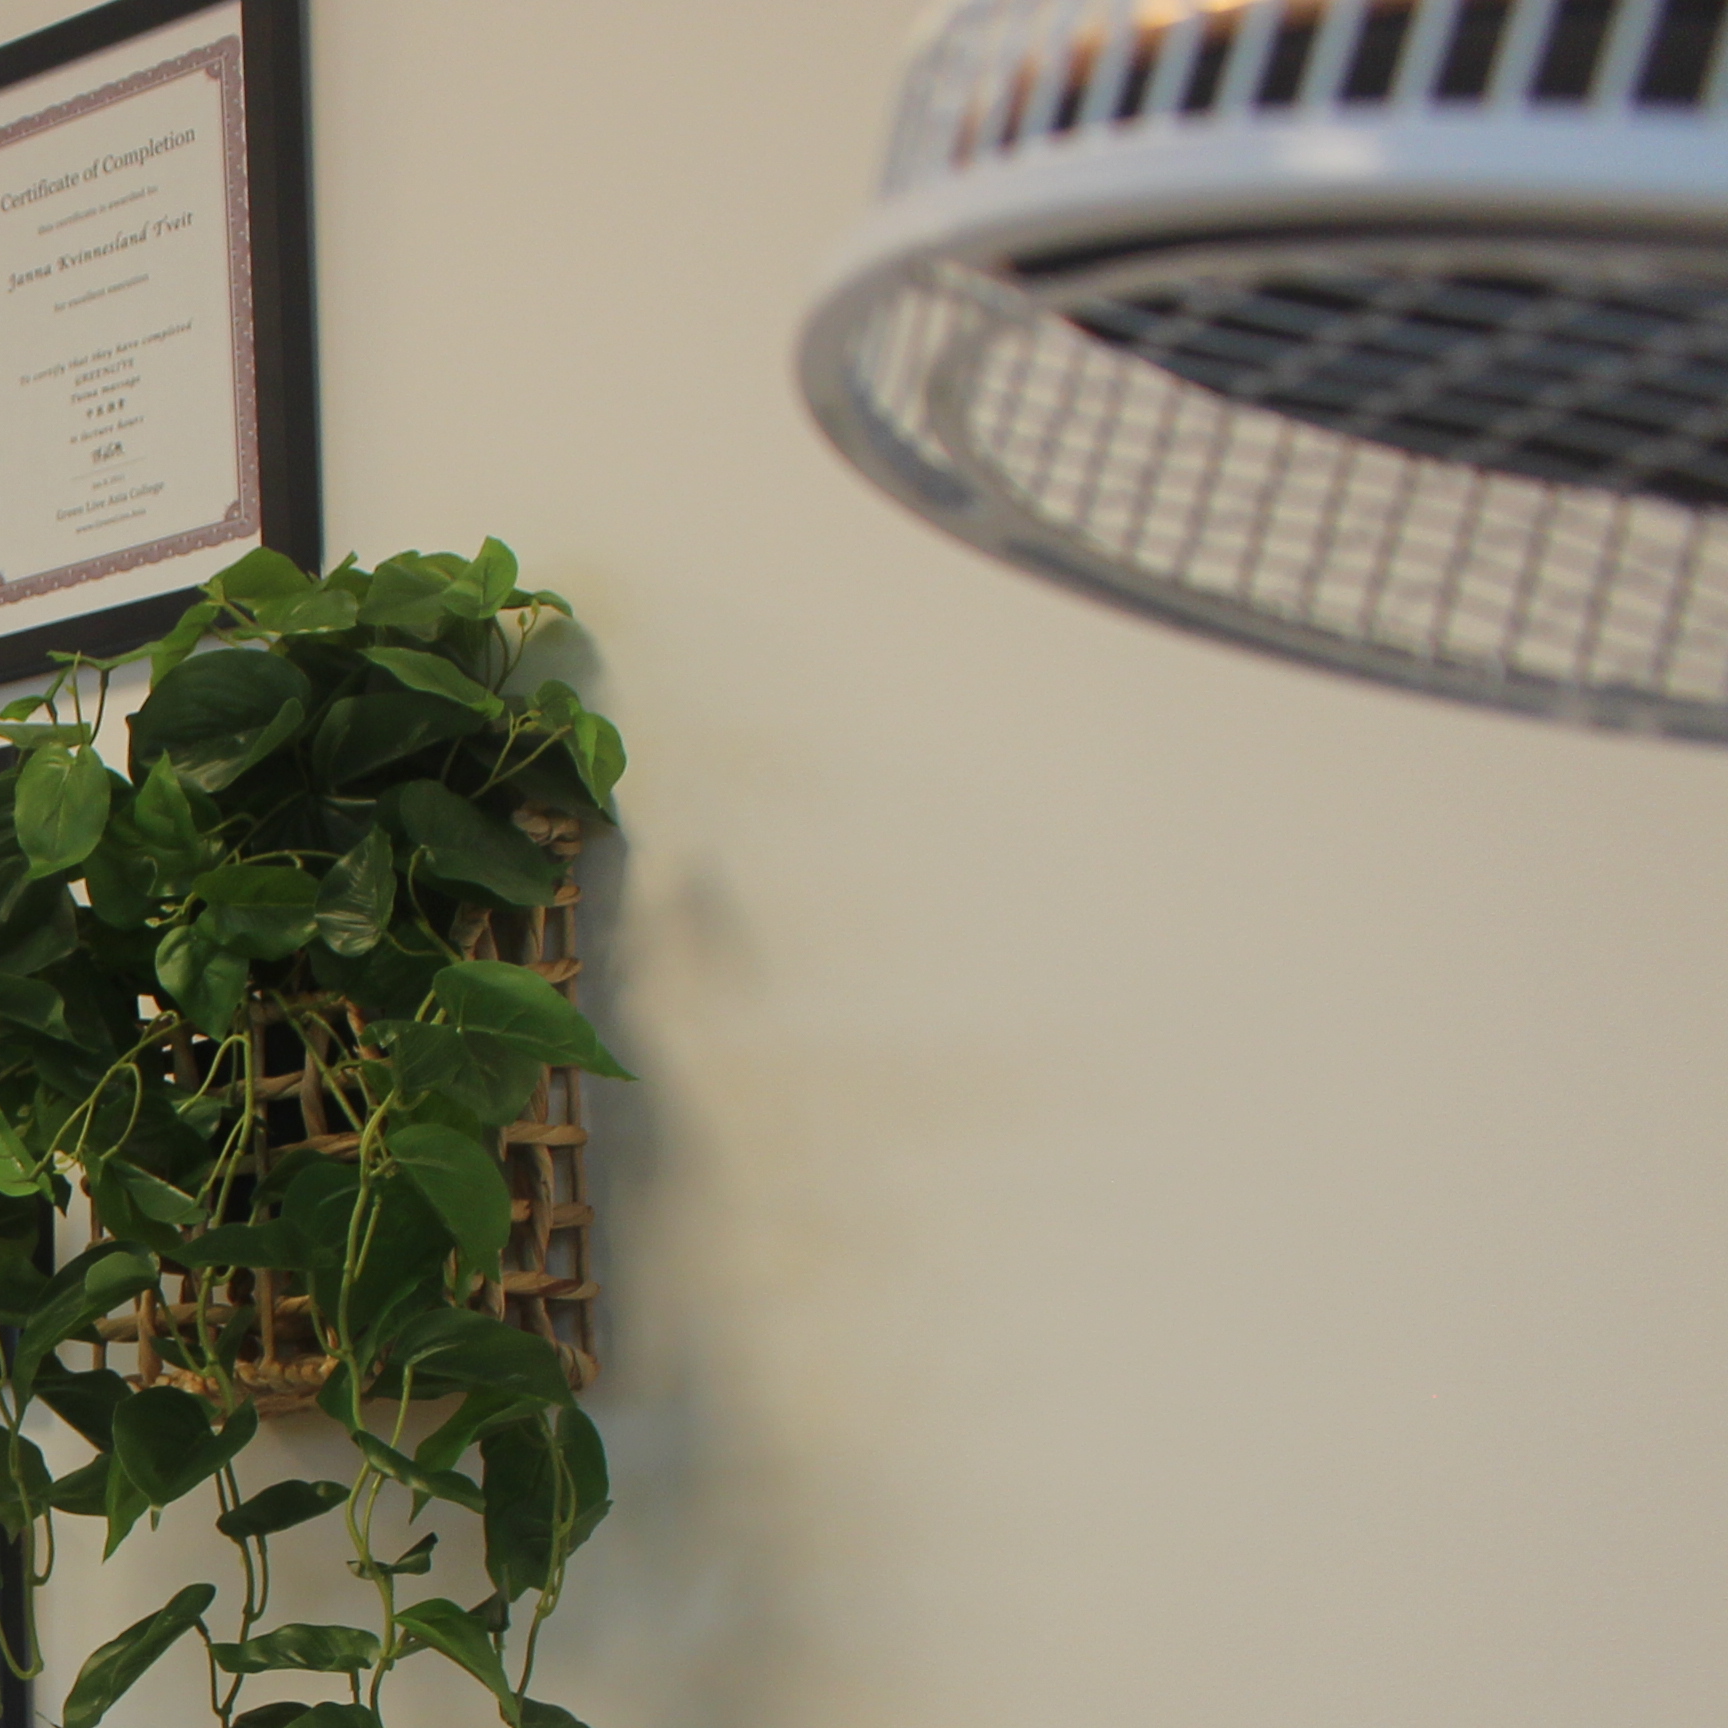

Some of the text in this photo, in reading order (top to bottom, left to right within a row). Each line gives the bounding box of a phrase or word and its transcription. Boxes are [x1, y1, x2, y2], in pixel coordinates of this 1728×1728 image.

[0, 127, 196, 212] Certificate of Completion
[153, 211, 193, 238] Tveit
